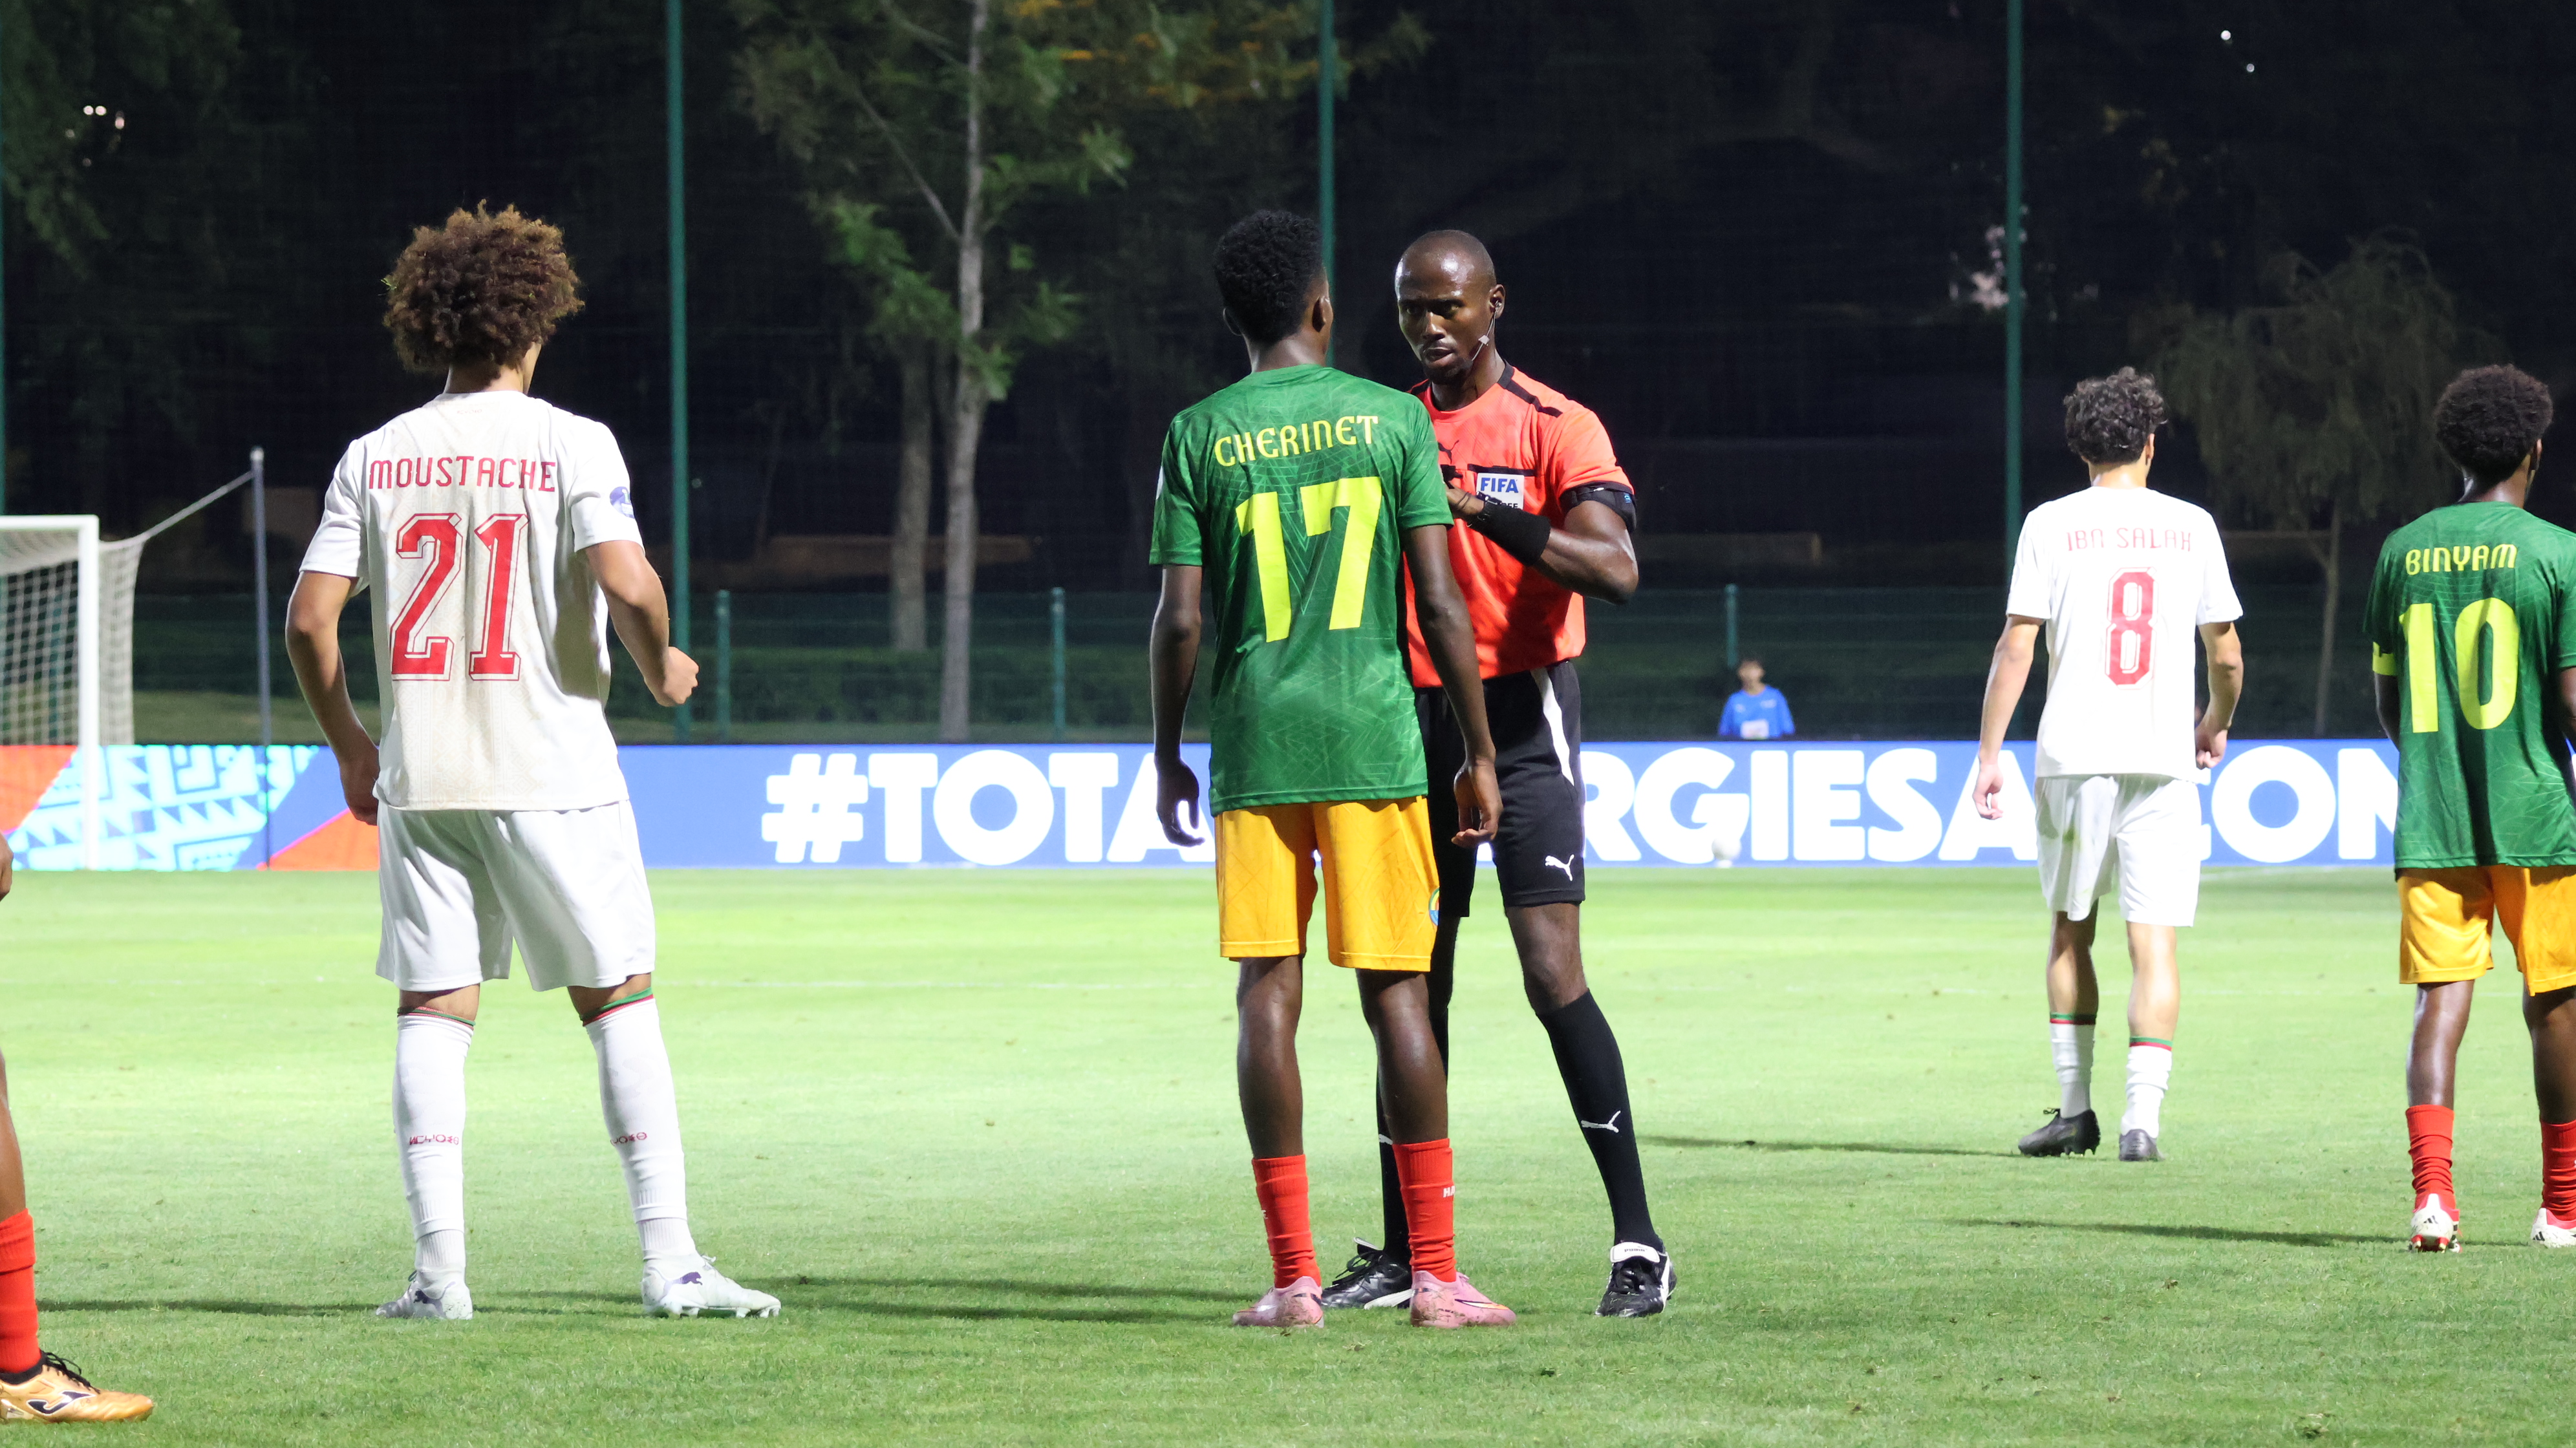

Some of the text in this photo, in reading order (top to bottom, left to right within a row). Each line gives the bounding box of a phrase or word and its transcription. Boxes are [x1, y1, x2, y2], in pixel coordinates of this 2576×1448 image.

[1214, 414, 1379, 467] CHERINET
[369, 455, 556, 493] MOUSTACHE
[1480, 477, 1519, 493] FIFA
[1235, 476, 1382, 643] 17
[2066, 527, 2191, 552] IBN SALAH
[2405, 543, 2518, 577] BINYAM
[389, 512, 529, 681] 21
[2104, 566, 2159, 690] 8
[2398, 597, 2520, 733] 10
